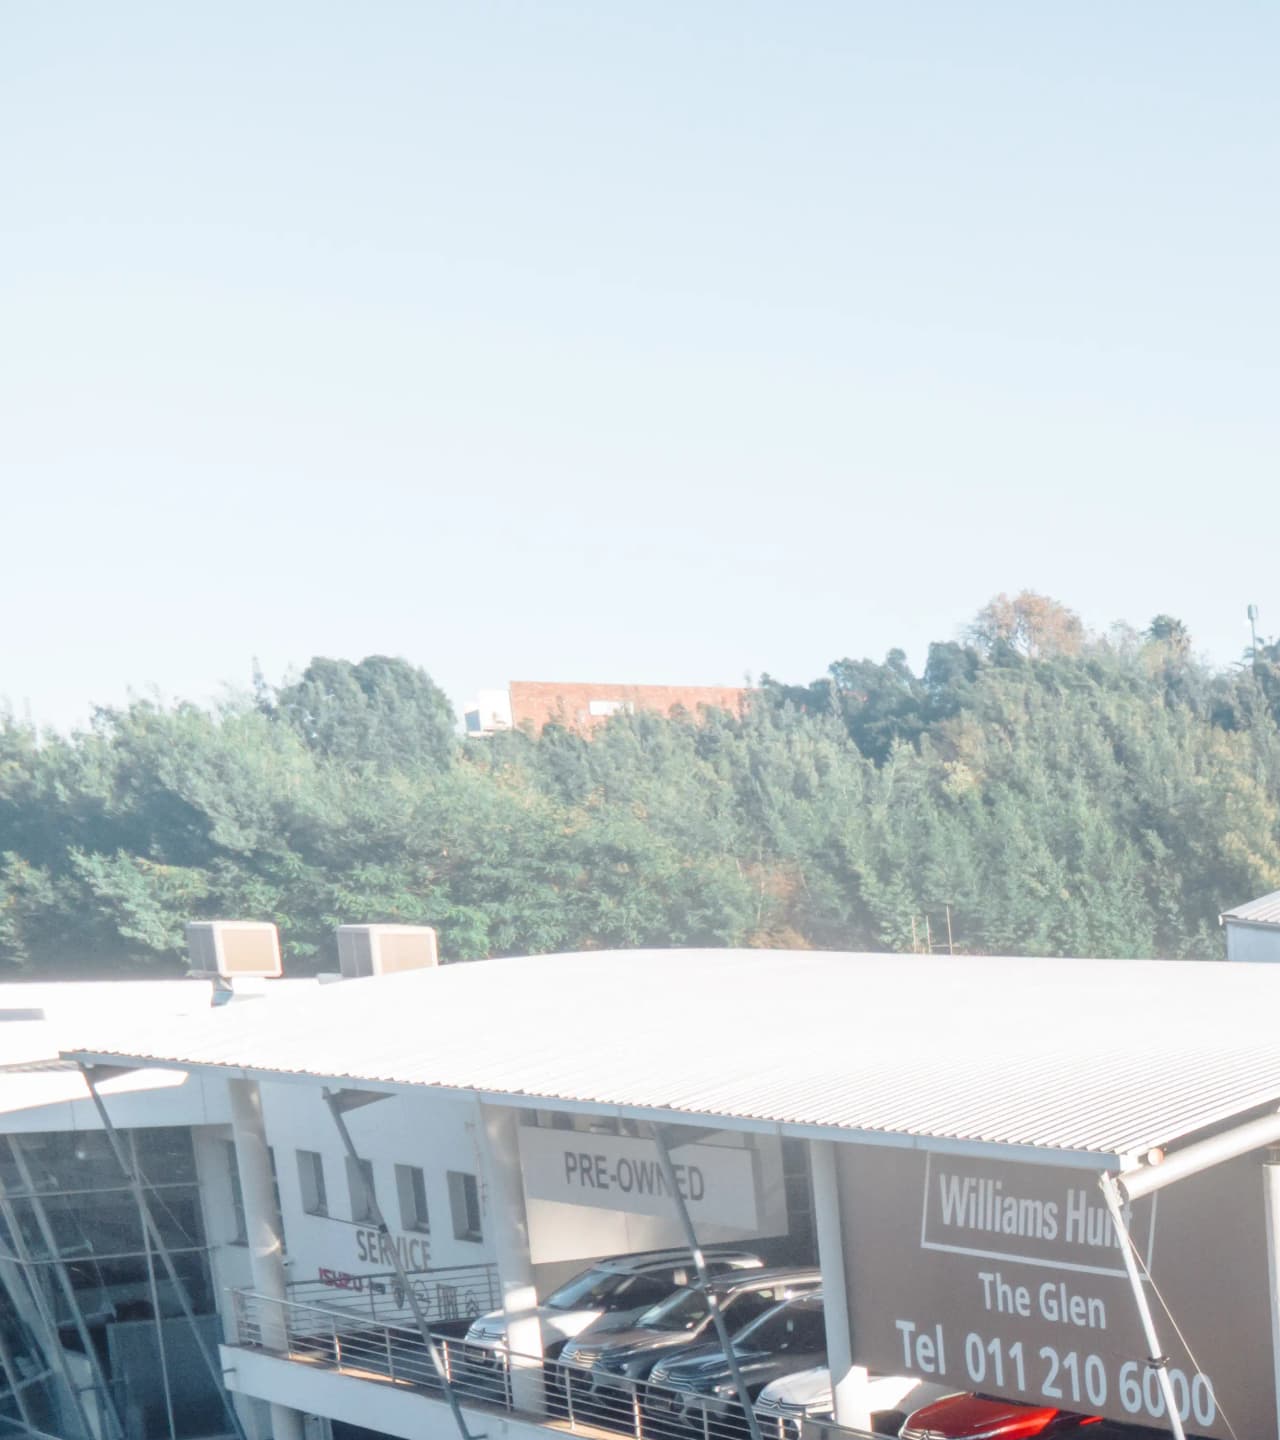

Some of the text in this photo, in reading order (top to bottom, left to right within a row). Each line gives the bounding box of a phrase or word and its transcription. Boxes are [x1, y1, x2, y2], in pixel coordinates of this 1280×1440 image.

[565, 1150, 705, 1202] PRE-OWNED
[939, 1173, 1058, 1242] Williams
[978, 1272, 1106, 1329] The Glen
[896, 1319, 1217, 1428] Tel 011 210 6000
